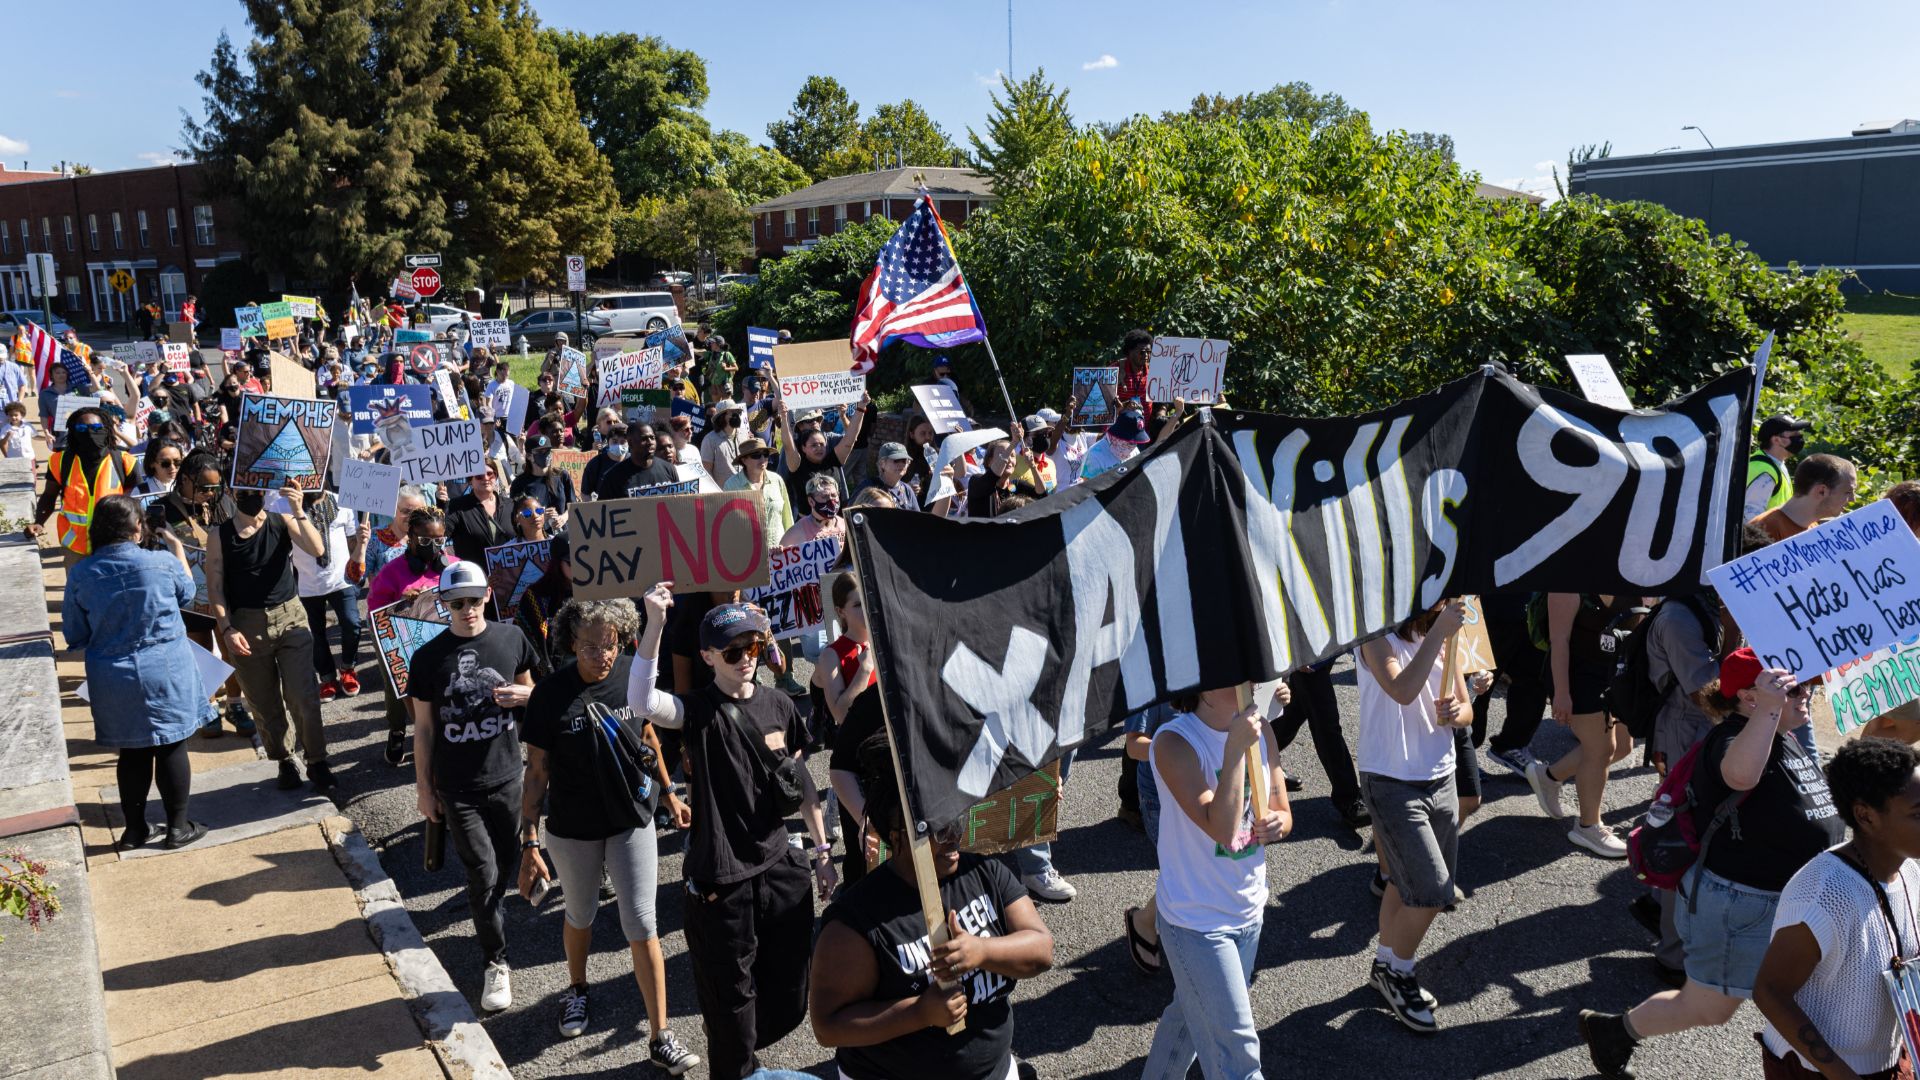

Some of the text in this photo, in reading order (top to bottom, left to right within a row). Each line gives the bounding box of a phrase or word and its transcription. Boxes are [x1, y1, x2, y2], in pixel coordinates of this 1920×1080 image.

[413, 276, 439, 288] STOP
[240, 312, 258, 324] NOT
[472, 320, 508, 329] COME FOR
[113, 345, 135, 353] ELON
[475, 336, 486, 344] US
[602, 358, 618, 373] WE
[620, 351, 645, 368] WONT
[645, 348, 661, 361] STAY
[605, 362, 651, 389] SILENT
[1074, 369, 1117, 385] MEMPHIS
[384, 388, 395, 396] NO
[622, 393, 644, 403] PEOPLE
[782, 382, 819, 396] STOP
[833, 385, 862, 395] FUTURE
[242, 396, 336, 428] MEMPHIS
[355, 411, 371, 420] FOR
[637, 405, 656, 413] OVER
[422, 422, 476, 450] DUMP
[345, 465, 363, 478] NO
[401, 449, 480, 481] TRUMP
[234, 471, 275, 488] NOT
[341, 491, 358, 506] MY
[575, 504, 637, 539] WE
[657, 498, 763, 585] NO
[802, 538, 836, 561] CAN
[488, 541, 553, 571] MEMPH
[573, 545, 643, 586] SAY
[942, 393, 1740, 798] xAI Kills 901
[1774, 557, 1906, 630] Hate has
[374, 610, 396, 640] NOT
[1806, 622, 1874, 668] home
[1873, 600, 1920, 636] her
[1832, 646, 1920, 736] MEMPHI
[444, 711, 515, 743] CASH
[968, 791, 1055, 847] FIT
[972, 969, 1009, 1005] ALL
